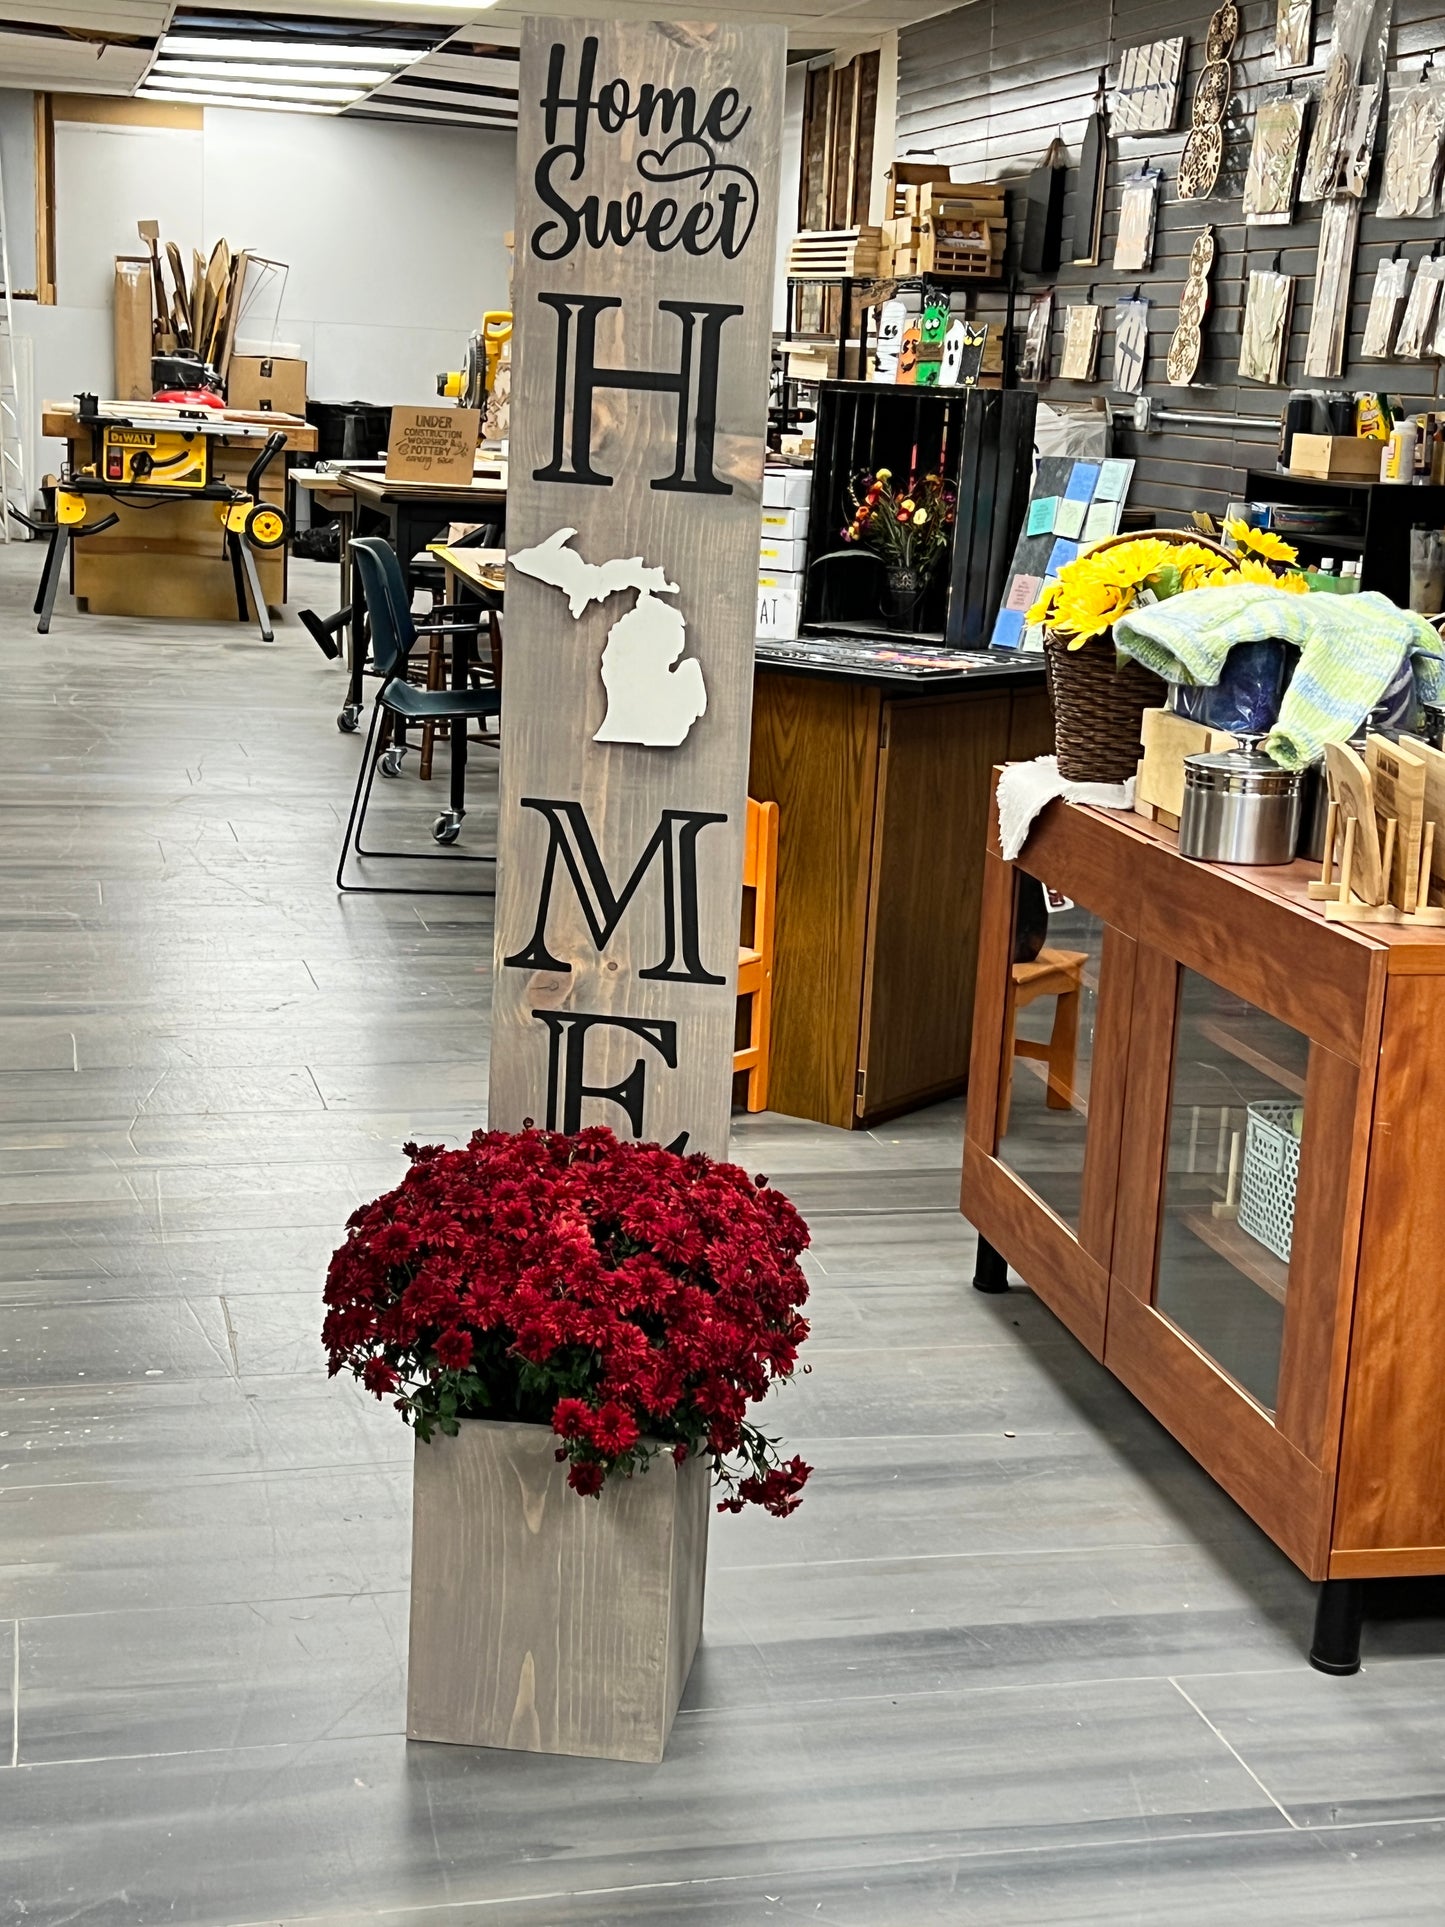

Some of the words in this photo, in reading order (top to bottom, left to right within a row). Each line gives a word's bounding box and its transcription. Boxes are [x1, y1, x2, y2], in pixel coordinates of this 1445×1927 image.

[540, 36, 752, 146] Home
[531, 144, 759, 261] Sweet
[415, 414, 453, 429] UNDER
[533, 292, 744, 496] H
[403, 428, 463, 439] CONSTRUCTION
[407, 437, 449, 446] WOODSHOP
[410, 446, 452, 456] POTTERY
[504, 797, 728, 987] M
